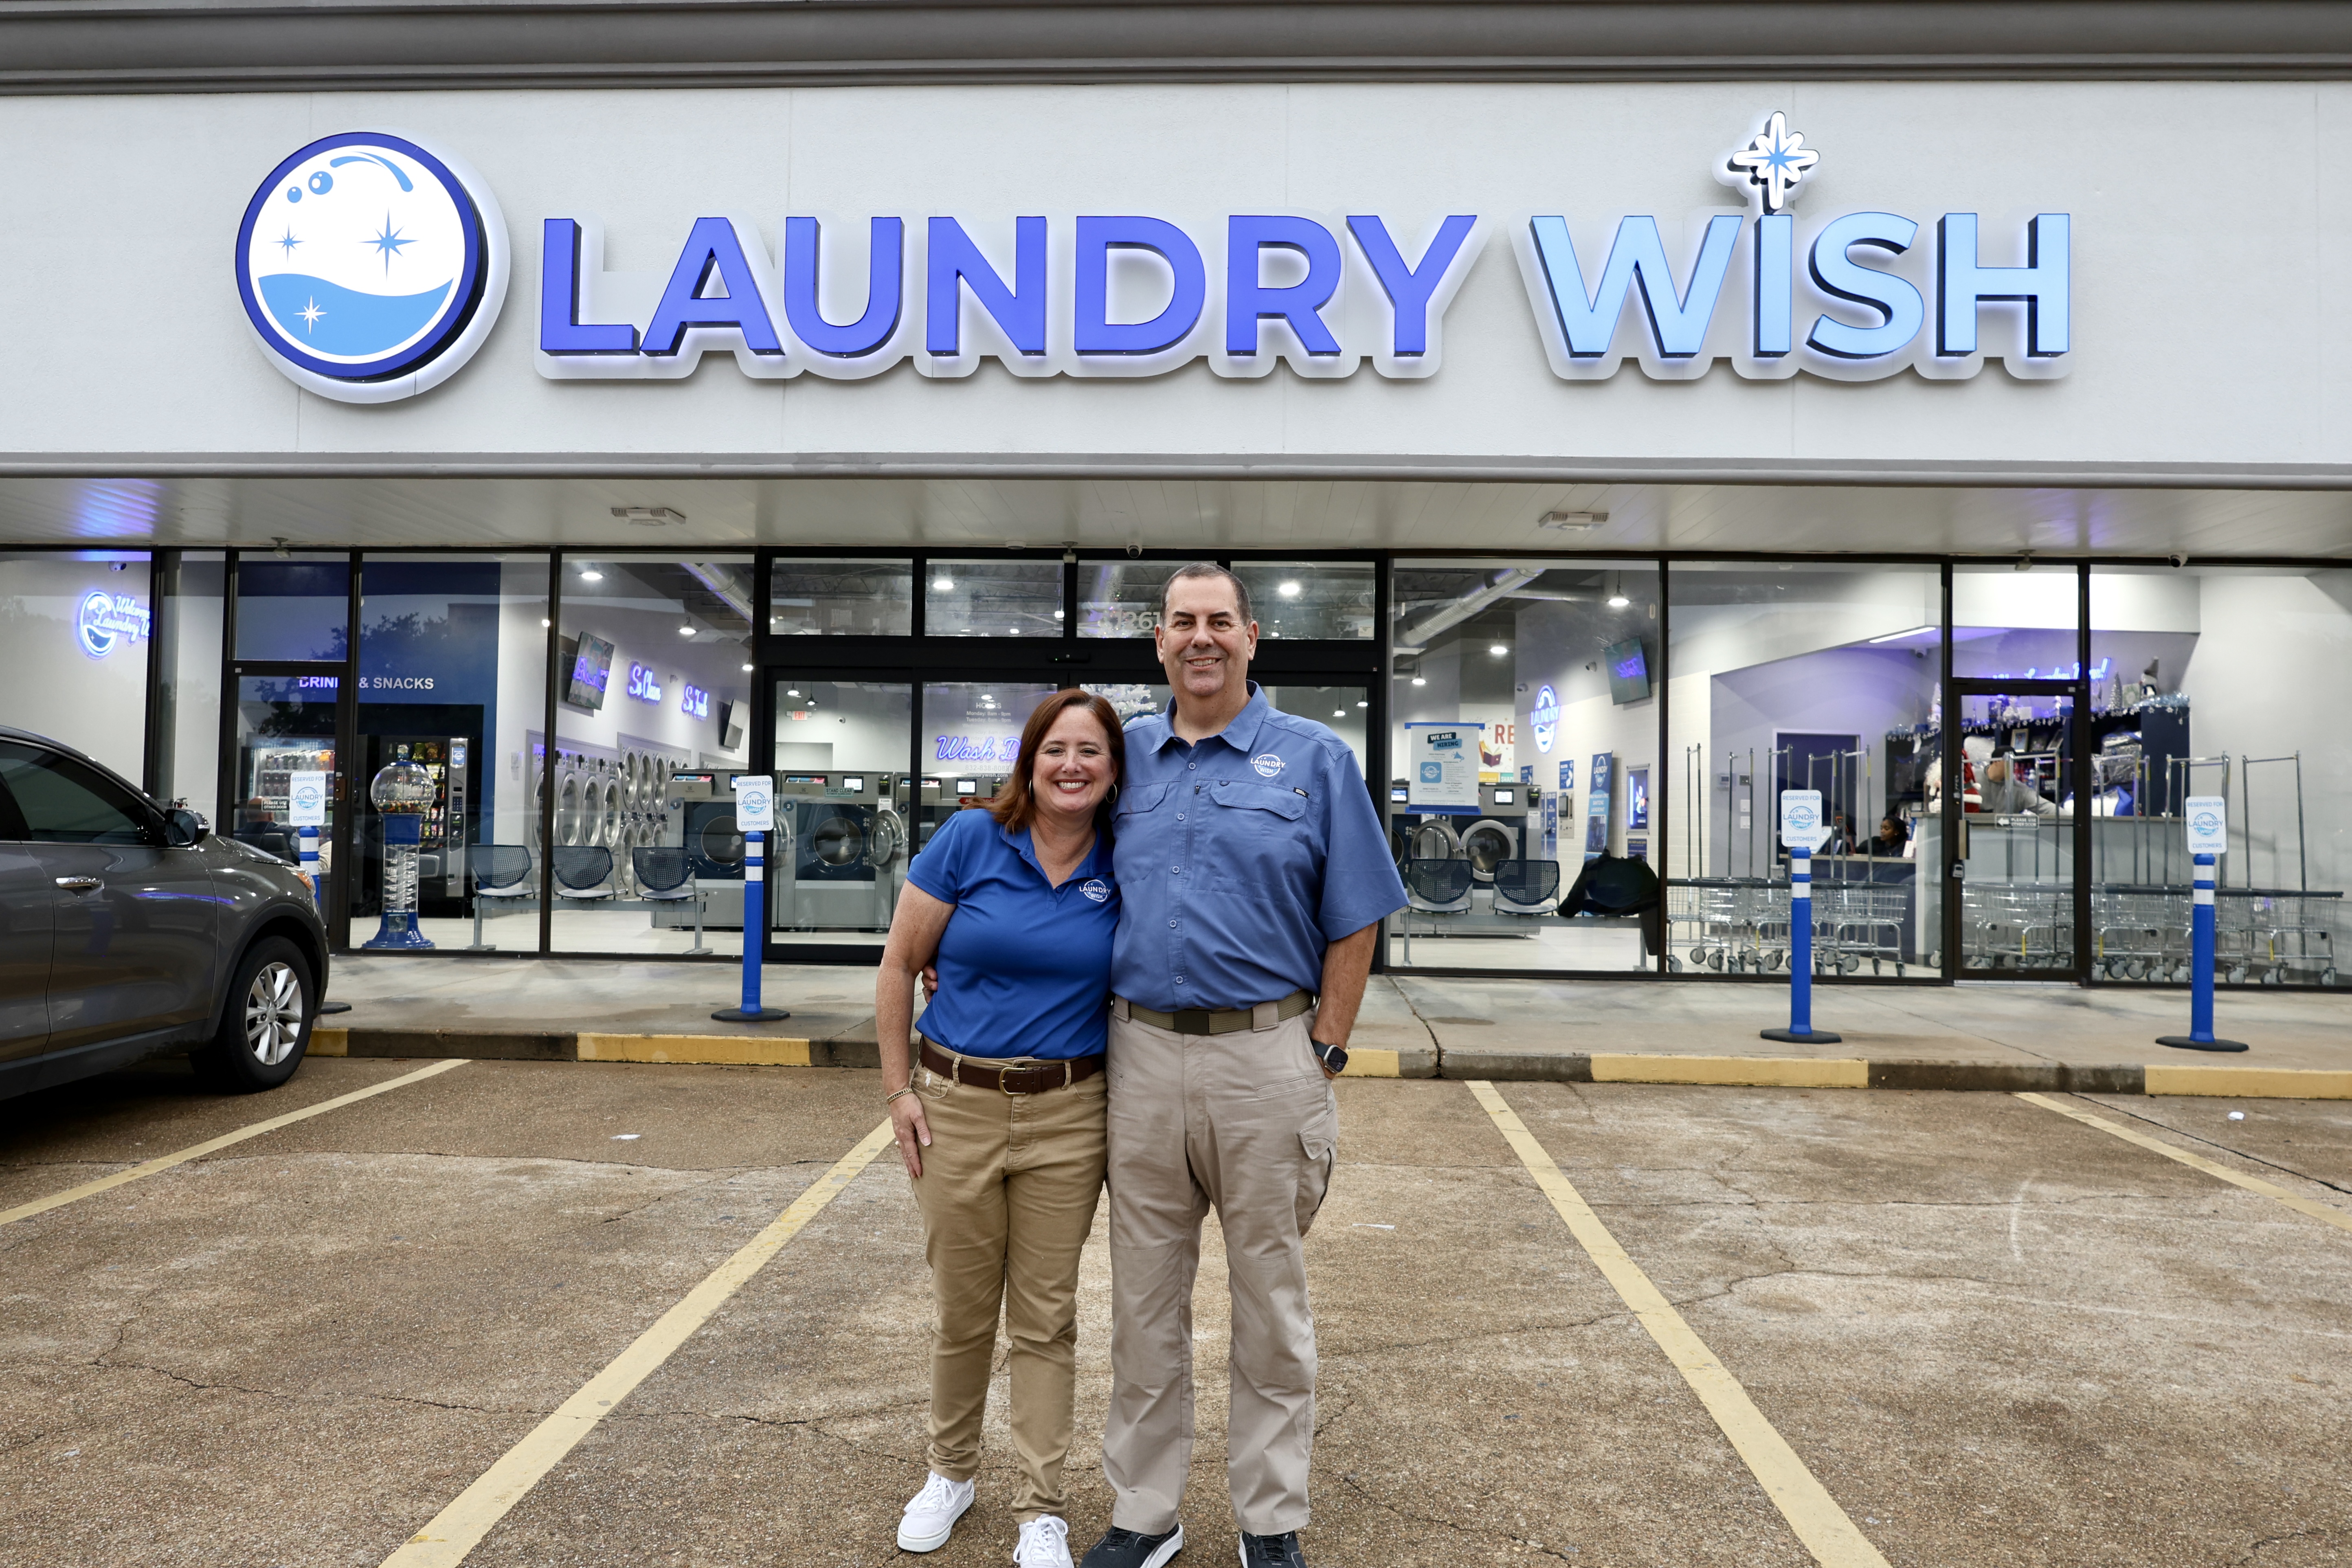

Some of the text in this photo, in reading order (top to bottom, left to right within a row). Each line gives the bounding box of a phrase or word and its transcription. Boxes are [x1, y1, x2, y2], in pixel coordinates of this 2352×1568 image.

[539, 211, 2071, 360] LAUNDRY WISH
[93, 607, 139, 641] Laundry
[299, 676, 434, 689] DRIN & SNACKS
[795, 711, 805, 720] EXIT
[1531, 705, 1560, 726] LAUNDRY
[937, 736, 995, 760] Wash
[1250, 758, 1286, 768] LAUNDRY
[1594, 765, 1608, 774] LAUNDRY
[1079, 886, 1111, 895] LAUNDRY
